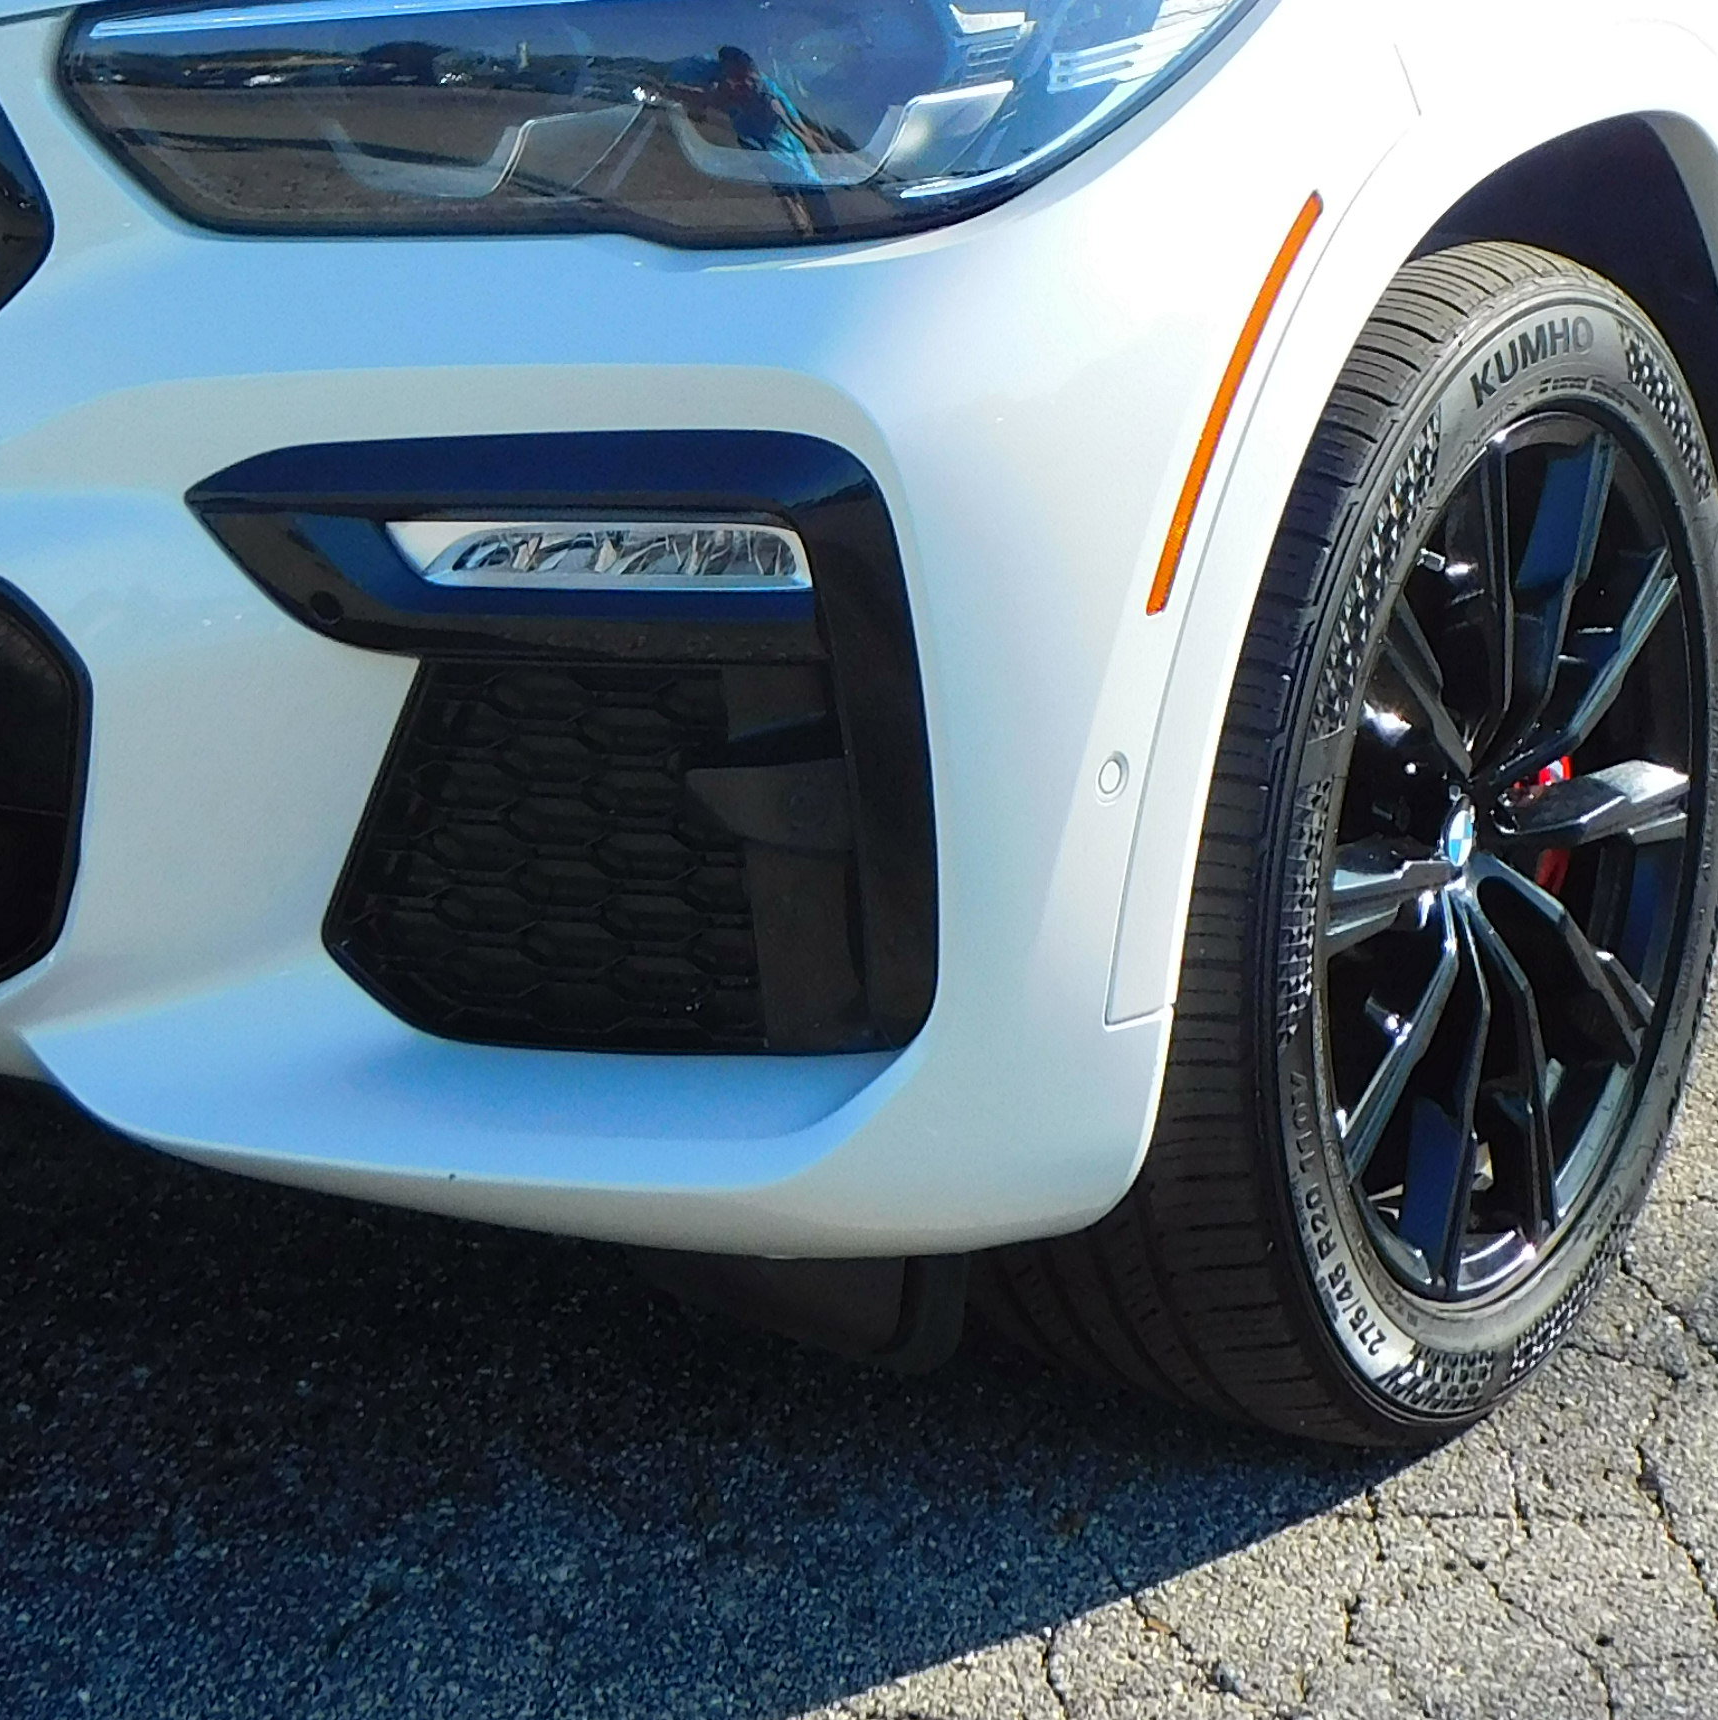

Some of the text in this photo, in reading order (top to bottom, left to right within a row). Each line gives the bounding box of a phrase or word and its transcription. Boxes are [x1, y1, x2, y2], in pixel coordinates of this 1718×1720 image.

[1470, 316, 1594, 409] KUMHO
[1305, 1183, 1338, 1261] R20
[1329, 1261, 1387, 1357] 275/45
